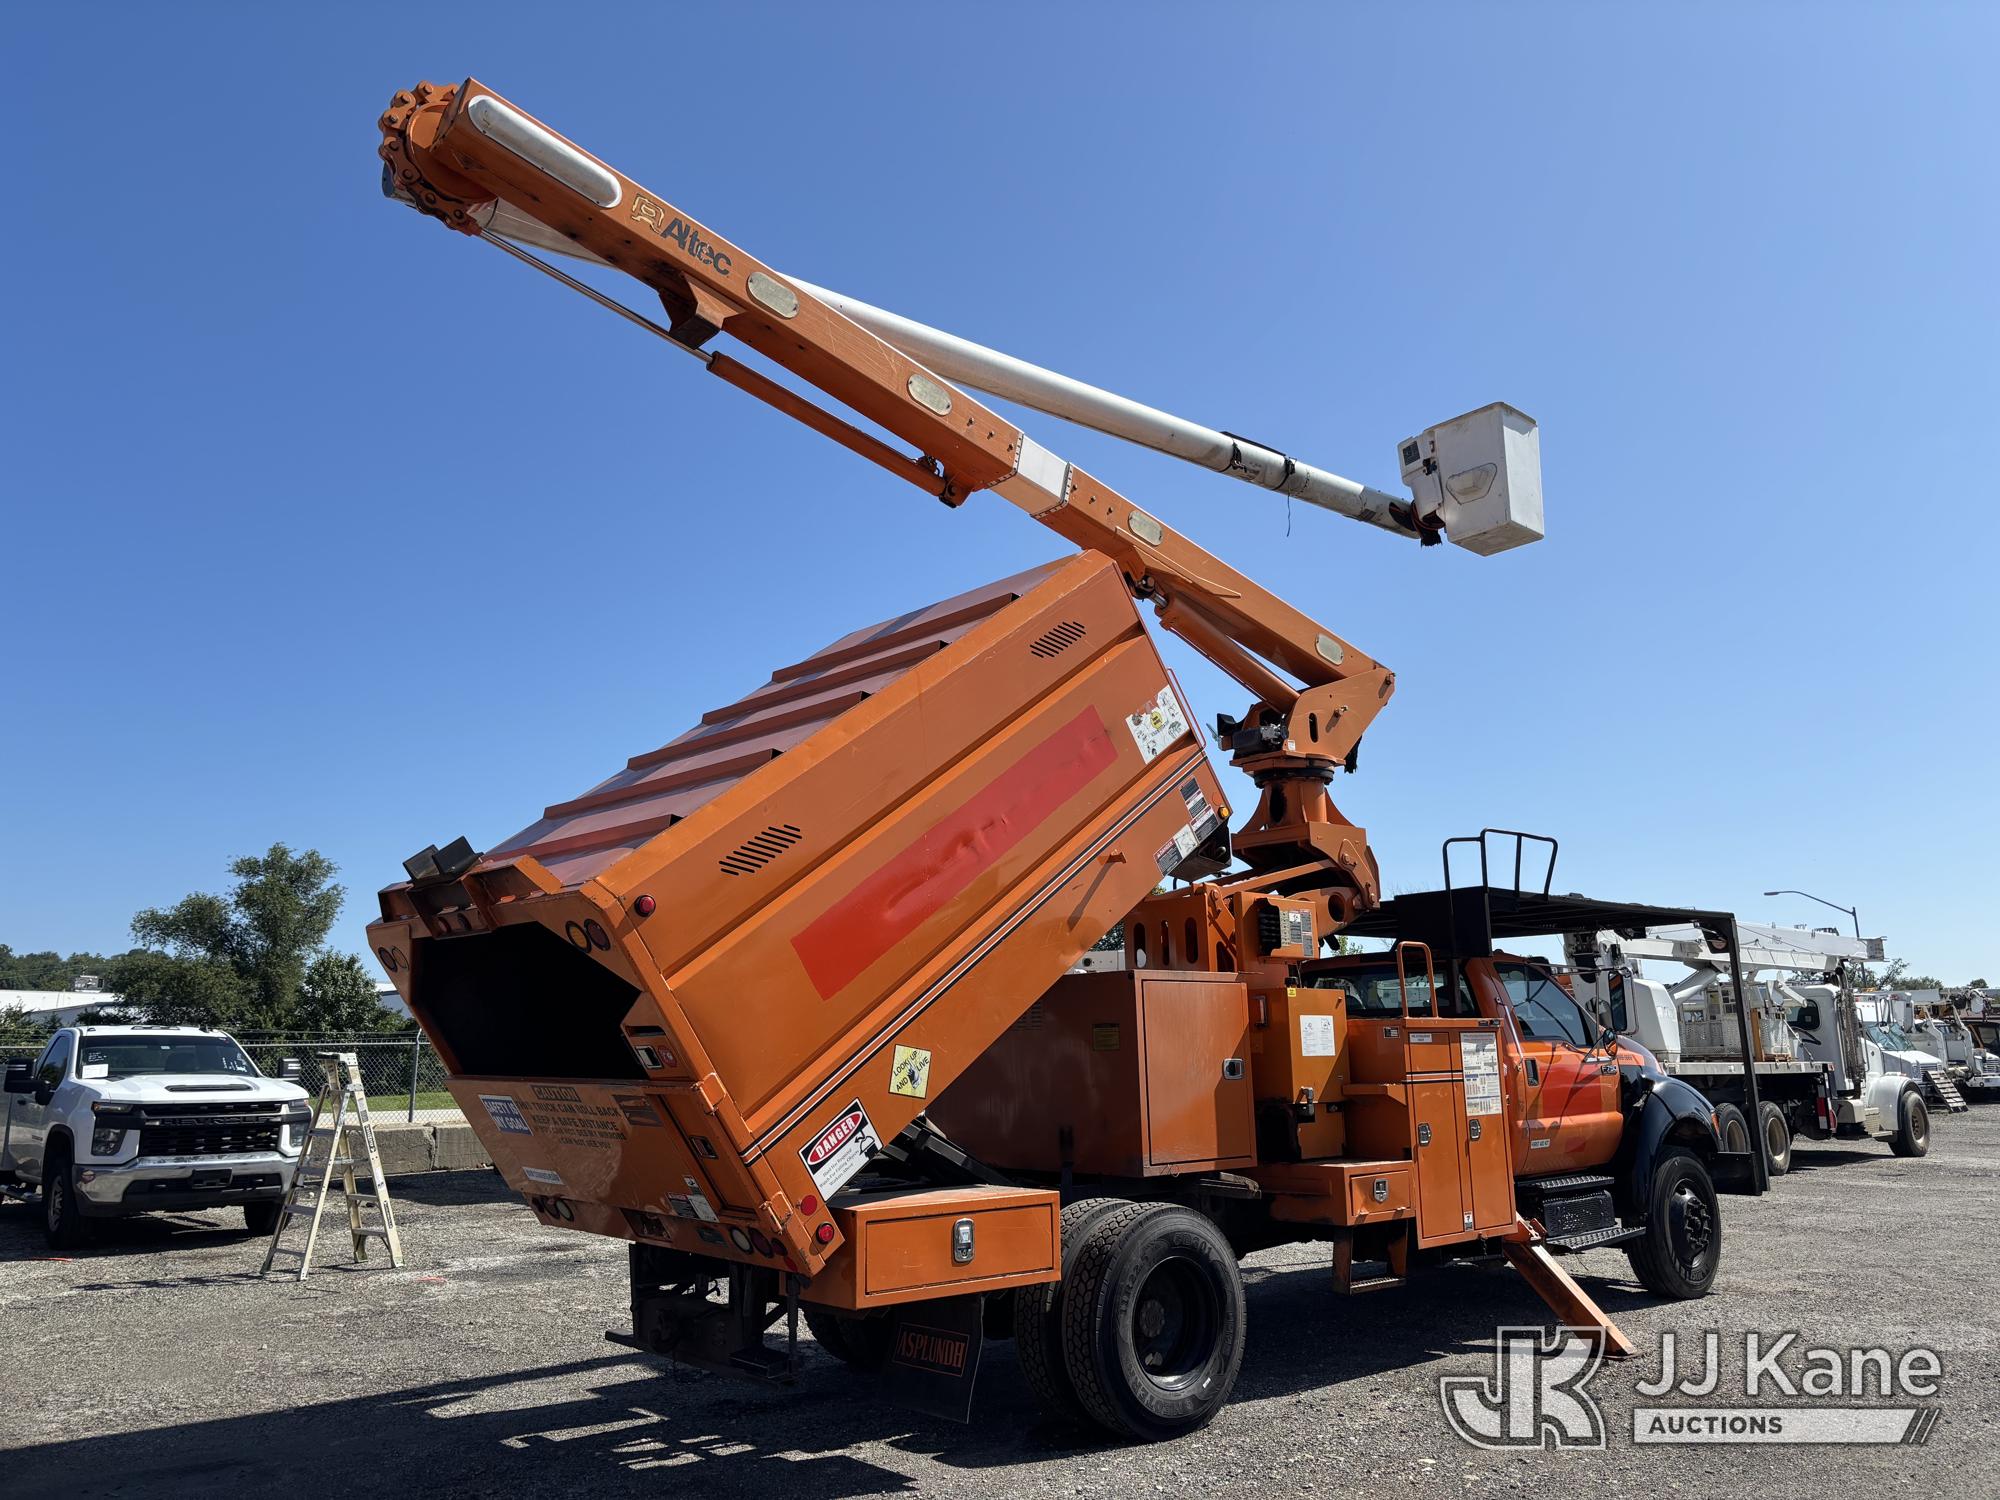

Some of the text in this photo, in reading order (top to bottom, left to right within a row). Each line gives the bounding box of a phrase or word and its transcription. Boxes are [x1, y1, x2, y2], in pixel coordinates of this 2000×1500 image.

[660, 217, 732, 275] Altec
[893, 1050, 918, 1077] LOOK UP
[896, 1056, 930, 1092] AND LIVE
[534, 1087, 580, 1102] CAUTION
[532, 1102, 559, 1113] TRUCK
[596, 1106, 622, 1117] BACK
[504, 1117, 529, 1131] GOAL
[576, 1118, 619, 1131] DISTANCE
[815, 1117, 856, 1159] DANGER
[896, 1330, 966, 1368] ASPLUNDH
